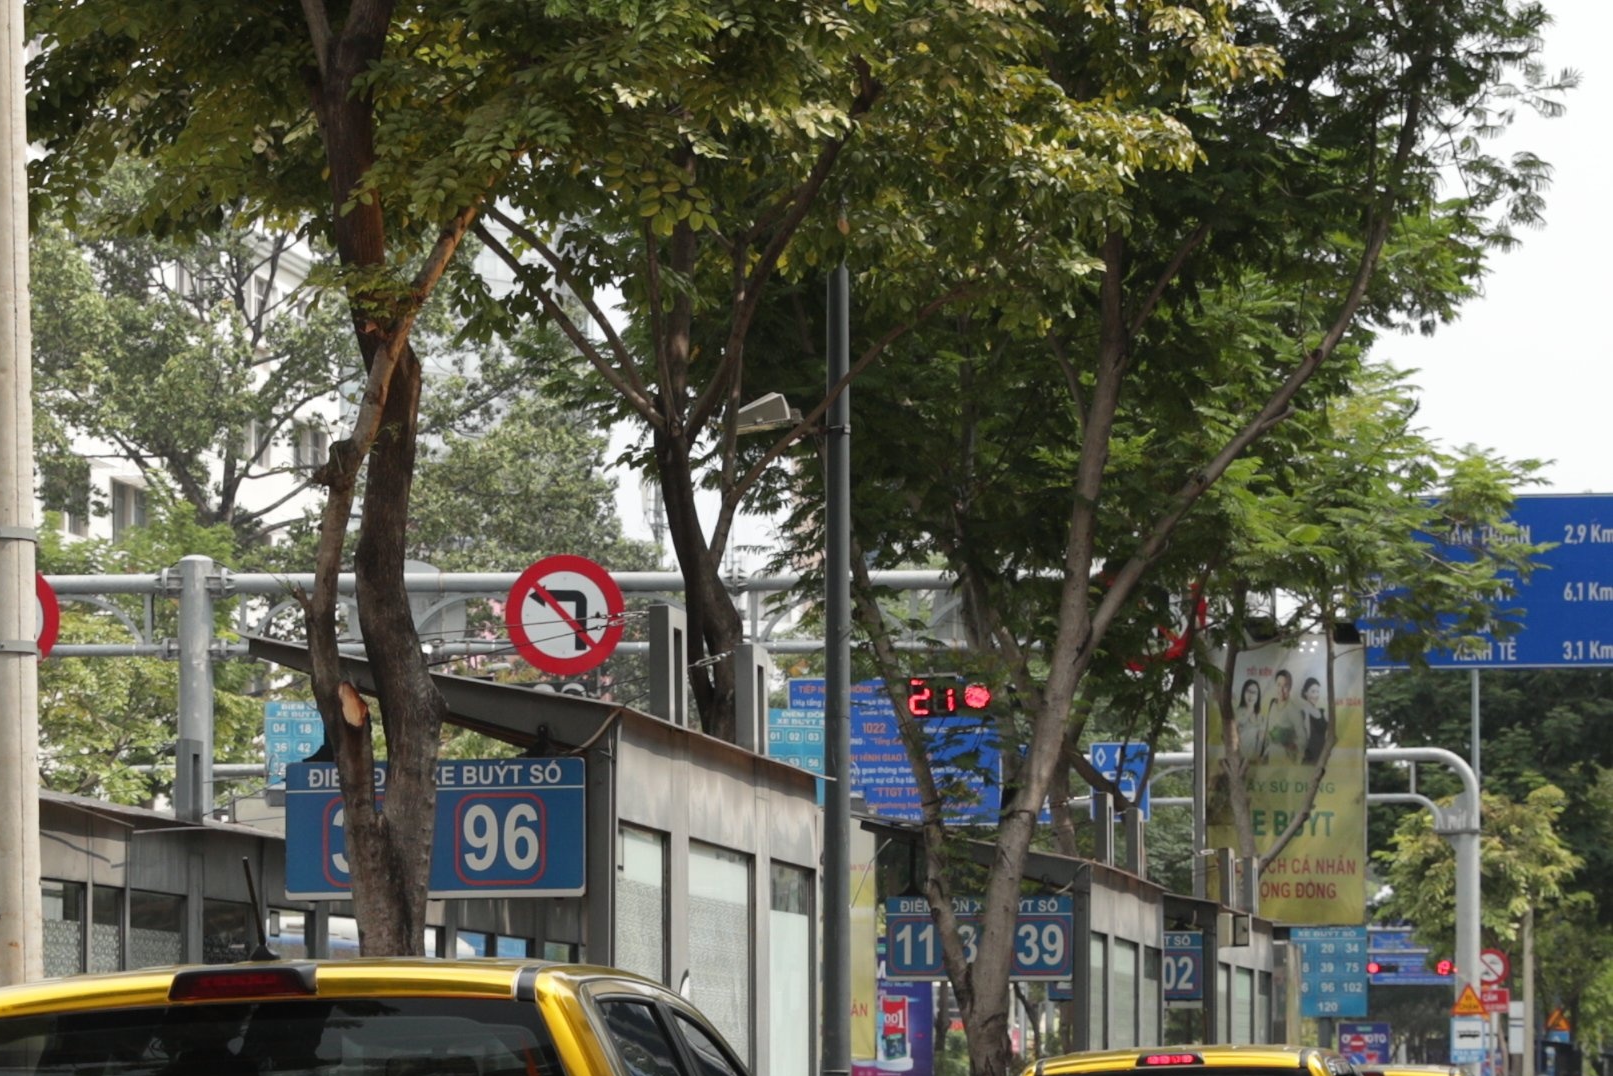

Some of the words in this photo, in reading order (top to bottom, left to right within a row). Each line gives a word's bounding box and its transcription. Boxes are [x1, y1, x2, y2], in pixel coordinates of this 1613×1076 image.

[1564, 524, 1587, 545] 2,9
[1590, 524, 1613, 543] Km
[1563, 582, 1584, 602] 6,1
[1588, 582, 1613, 601] Km
[1562, 640, 1584, 661] 3,1
[1589, 640, 1613, 660] Km
[908, 679, 955, 715] 21
[463, 762, 523, 785] BUÝT
[529, 761, 562, 784] SỐ
[1252, 809, 1267, 836] E
[463, 803, 539, 871] 96
[896, 924, 934, 966] 11
[1017, 924, 1065, 966] 39
[1164, 956, 1194, 990] 02
